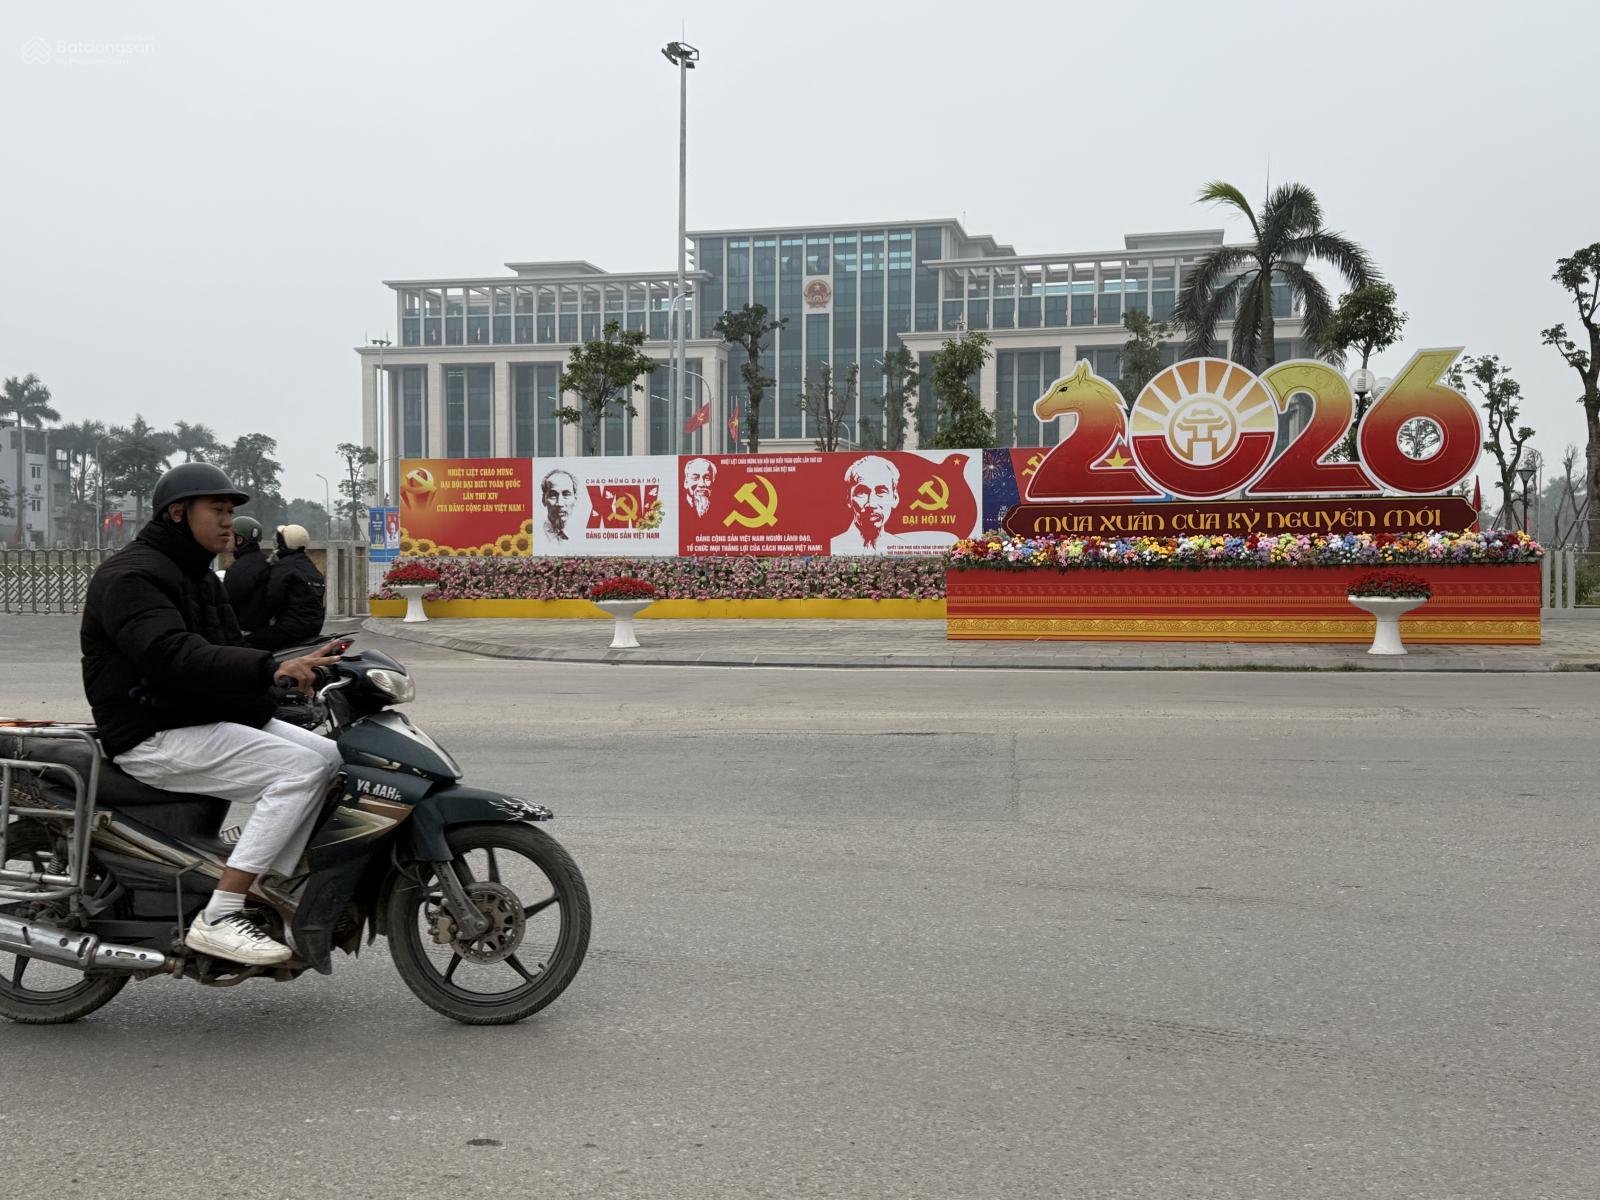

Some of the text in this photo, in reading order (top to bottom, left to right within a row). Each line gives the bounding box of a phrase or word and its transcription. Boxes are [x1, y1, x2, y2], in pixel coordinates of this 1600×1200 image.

[1025, 346, 1484, 501] 2026
[508, 504, 522, 512] NAM
[902, 513, 956, 526] ĐẠI HỘI XIV
[1034, 512, 1093, 533] MÙA
[1100, 512, 1165, 531] XUÂN
[1172, 509, 1220, 530] CỦA
[1267, 508, 1376, 531] NGUYÊN
[1383, 506, 1441, 527] MỚI
[586, 530, 602, 539] ĐẢNG
[602, 531, 618, 540] CỘNG
[619, 530, 632, 539] SẢN
[632, 530, 645, 540] VIỆT
